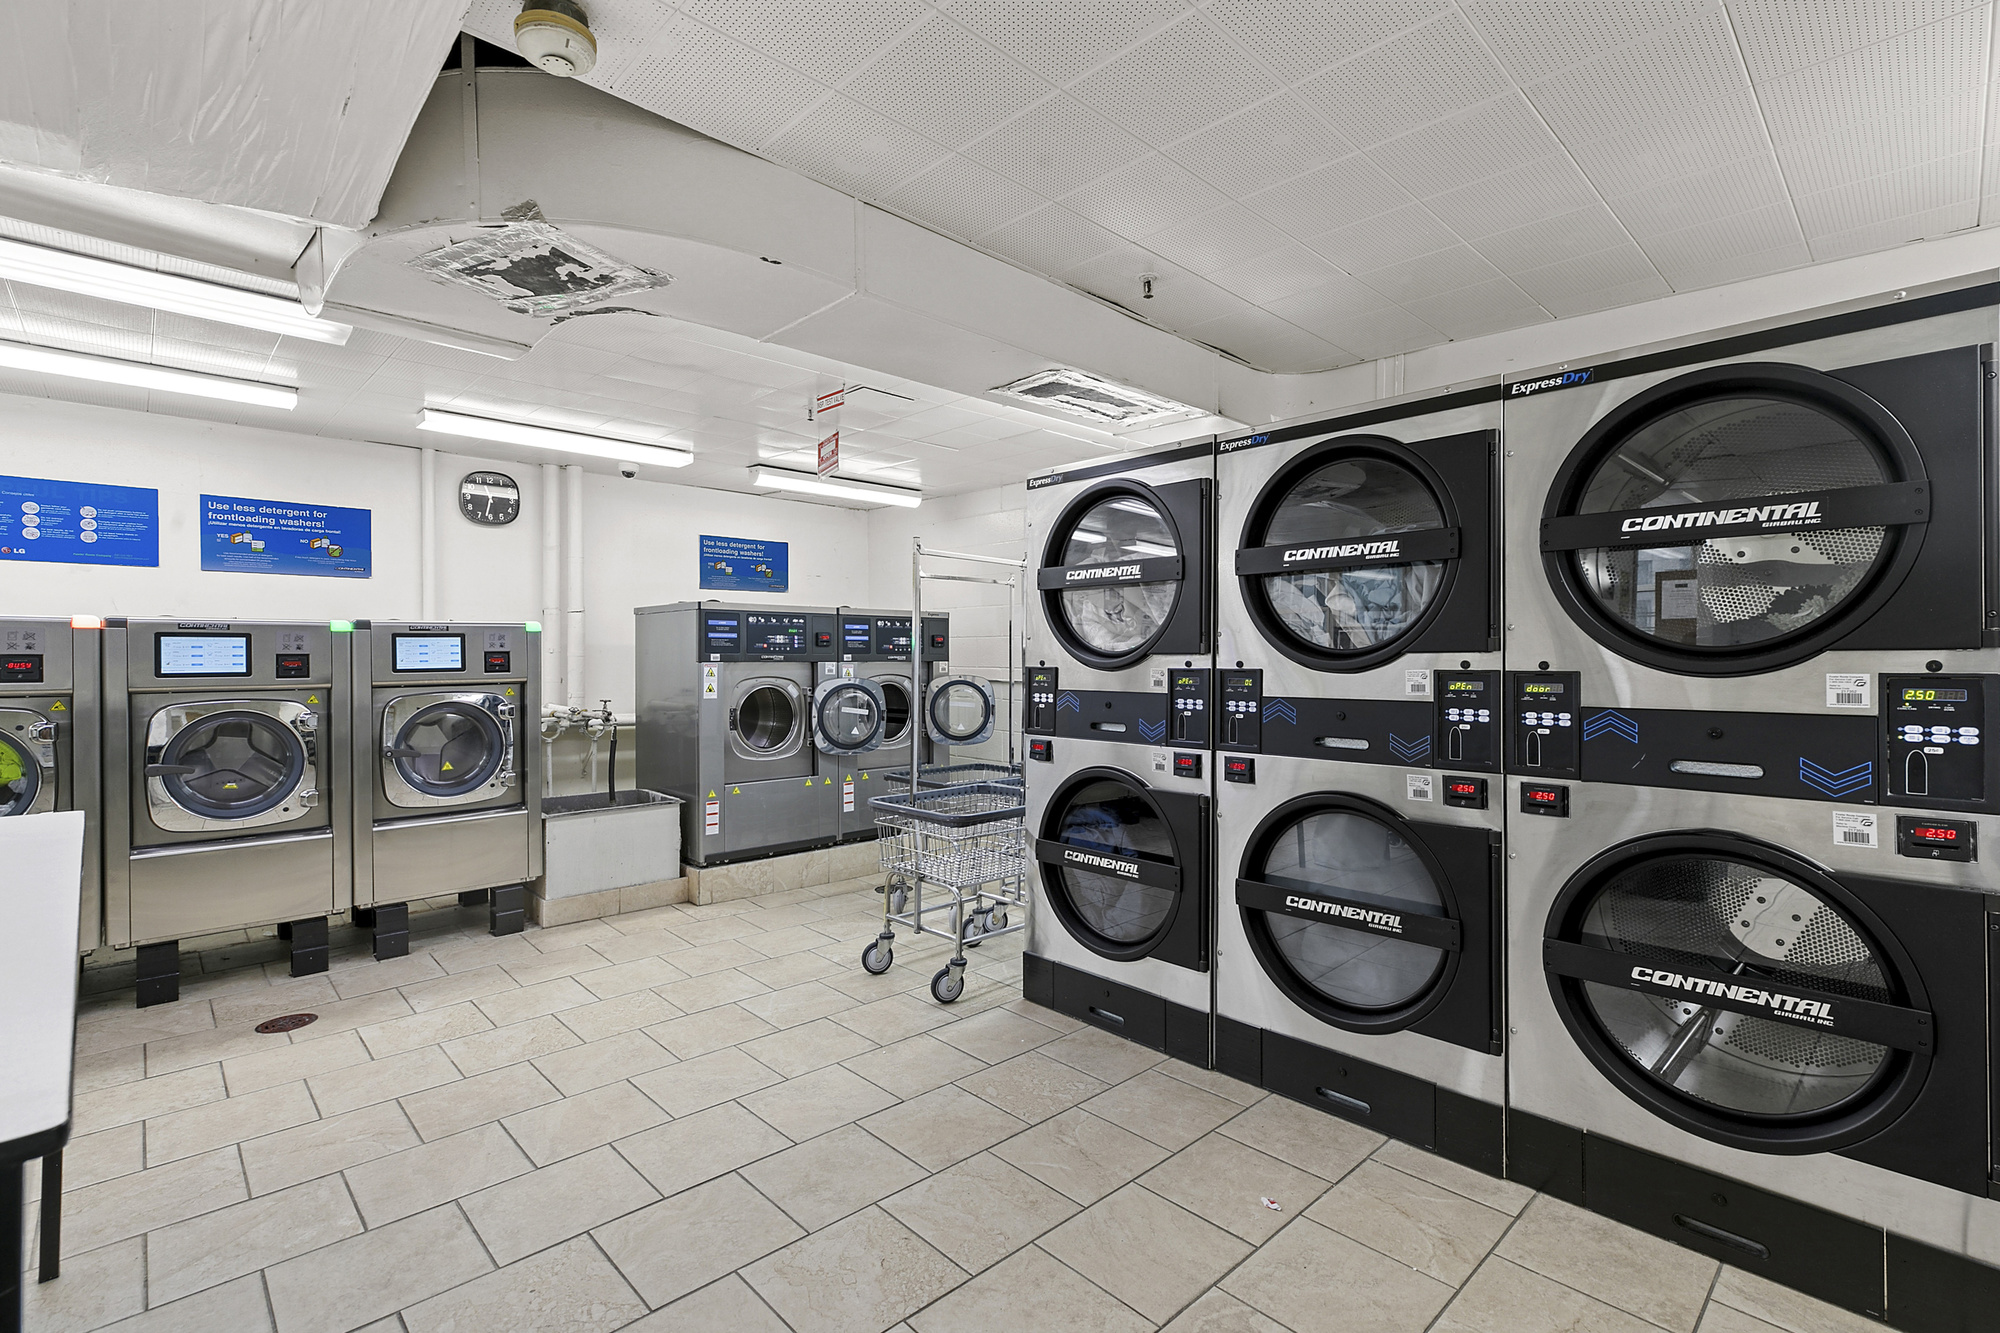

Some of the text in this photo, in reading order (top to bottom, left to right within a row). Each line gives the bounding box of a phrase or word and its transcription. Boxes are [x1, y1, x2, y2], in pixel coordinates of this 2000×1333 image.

[1511, 371, 1591, 394] ExpressDry
[1220, 435, 1269, 451] ExpressDry
[1030, 475, 1062, 488] ExpressDry
[208, 501, 327, 518] Use less detergent for
[1621, 502, 1822, 532] CONTINENTAL
[208, 512, 324, 528] frontloading washers!
[703, 547, 738, 556] frontloading
[729, 542, 756, 550] detergent
[1284, 540, 1400, 561] CONTINENTAL
[1066, 565, 1141, 580] CONTINENTAL
[1905, 690, 1935, 700] 2.50
[1926, 828, 1956, 839] 2.50
[1064, 850, 1139, 874] CONTINENTAL
[1286, 896, 1402, 928] CONTINENTAL
[1630, 966, 1834, 1020] CONTINENTAL
